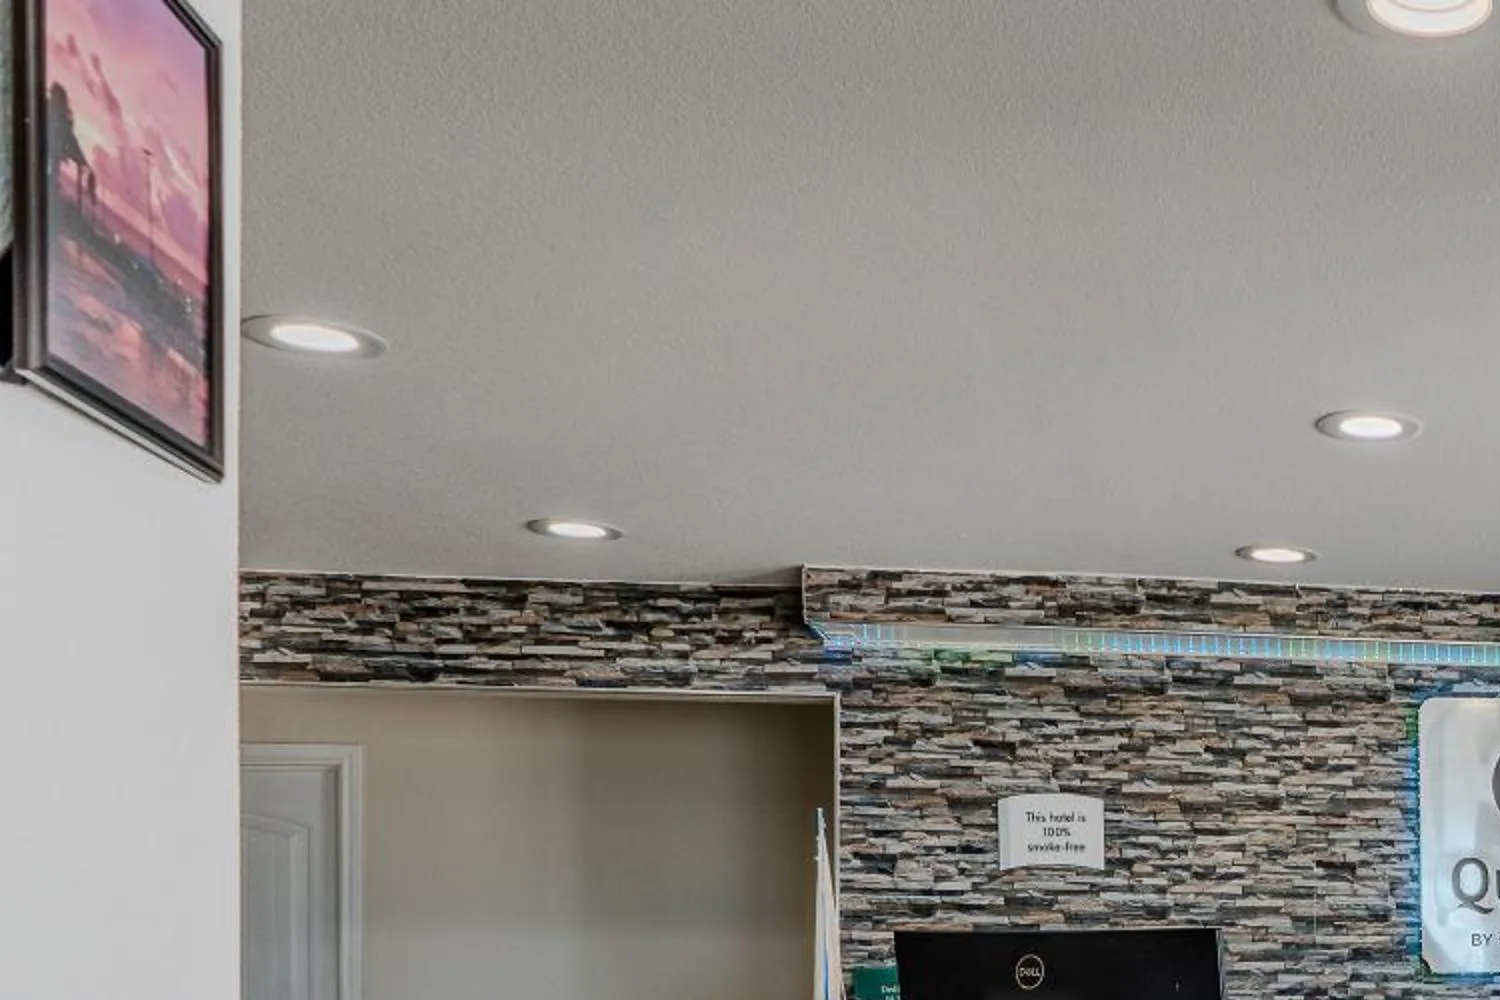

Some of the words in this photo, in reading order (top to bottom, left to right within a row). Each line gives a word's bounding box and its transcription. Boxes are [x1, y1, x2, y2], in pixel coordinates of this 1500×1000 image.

[1025, 811, 1047, 823] This
[1049, 811, 1075, 823] hotel
[1077, 811, 1087, 823] is
[1043, 827, 1072, 837] 100%
[1471, 932, 1493, 947] BY
[1019, 967, 1041, 977] DELL
